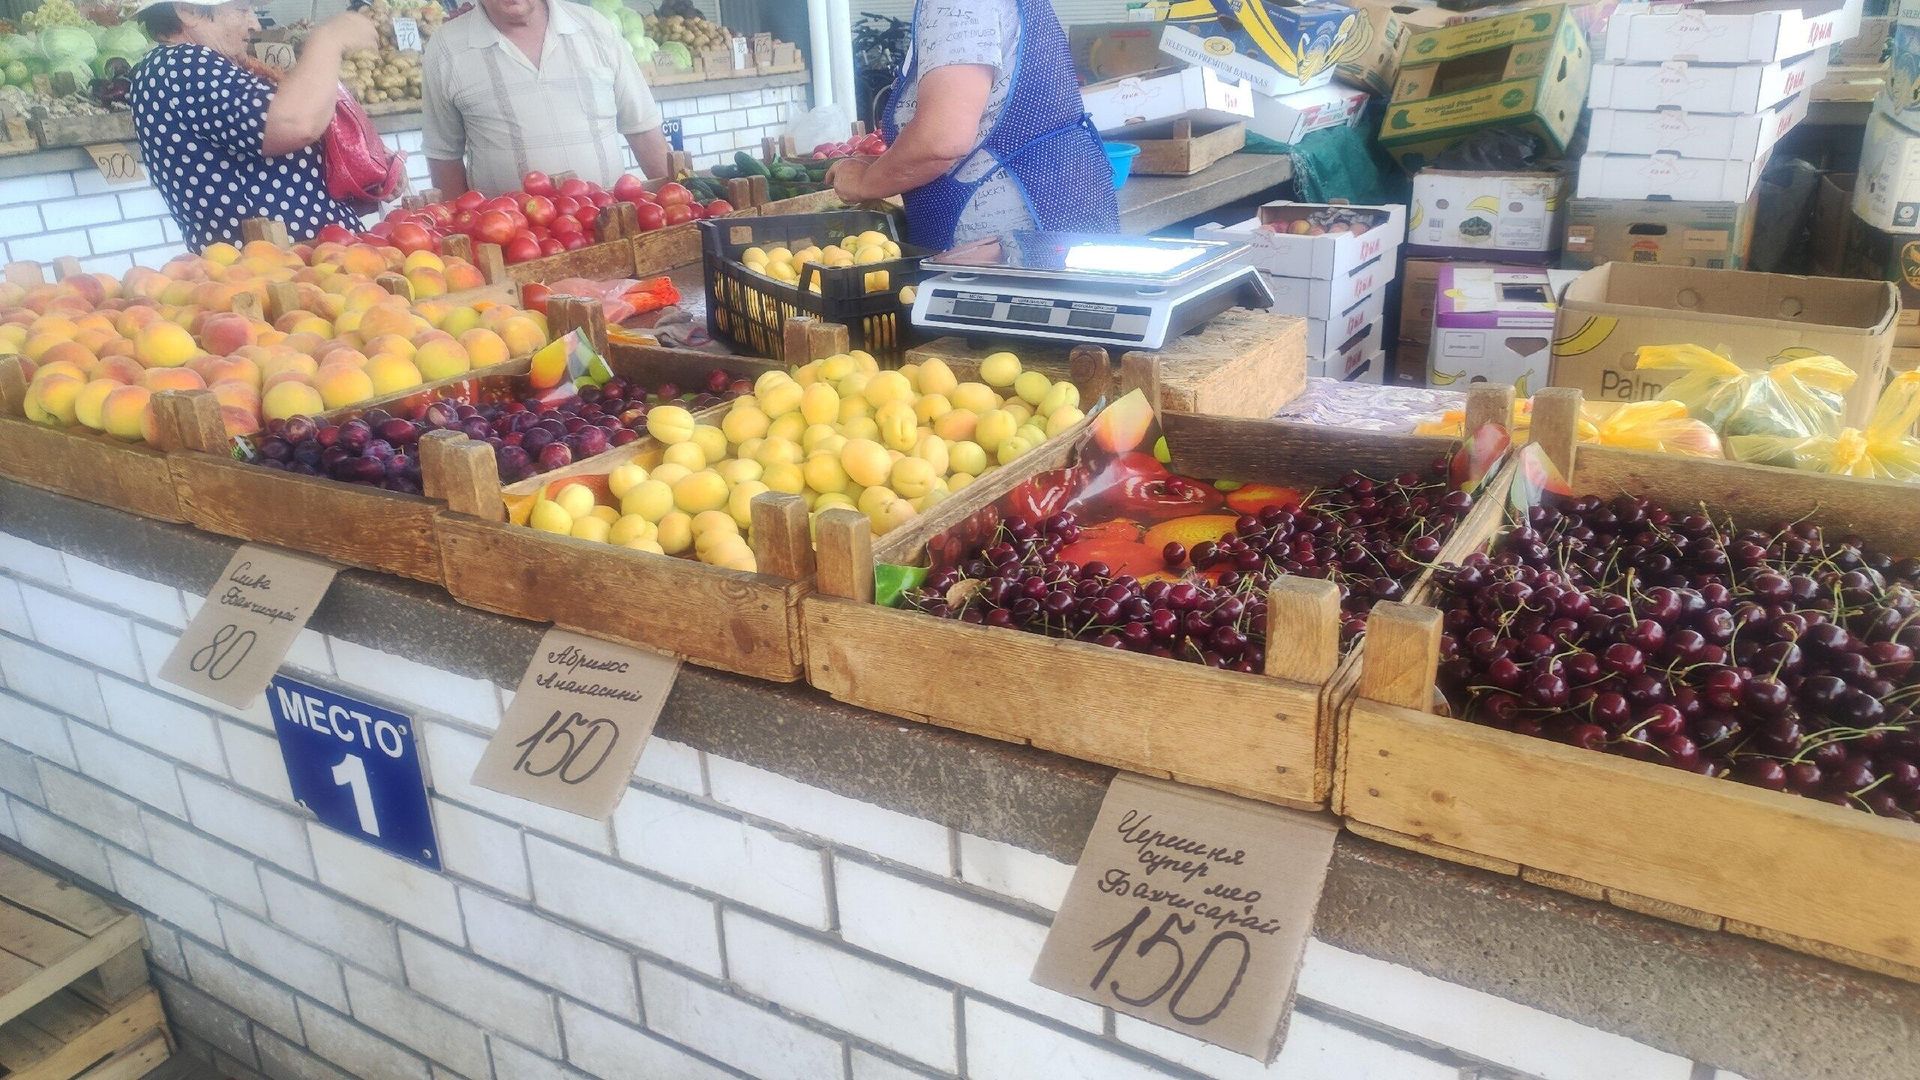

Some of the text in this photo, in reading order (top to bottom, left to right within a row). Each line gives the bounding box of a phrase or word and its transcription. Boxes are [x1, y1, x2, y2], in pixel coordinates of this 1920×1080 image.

[1165, 38, 1269, 87] SELECTED PREMIUM BANANAS
[662, 122, 679, 133] СТО
[190, 624, 257, 681] 80
[548, 645, 630, 675] Абрикос
[277, 686, 404, 758] МЕСТО
[512, 710, 620, 785] 150
[331, 753, 381, 838] 1
[1117, 809, 1246, 866] Черешня
[1138, 850, 1209, 883] супер
[1097, 868, 1282, 936] Бахчисарай
[1089, 906, 1251, 1026] 150
